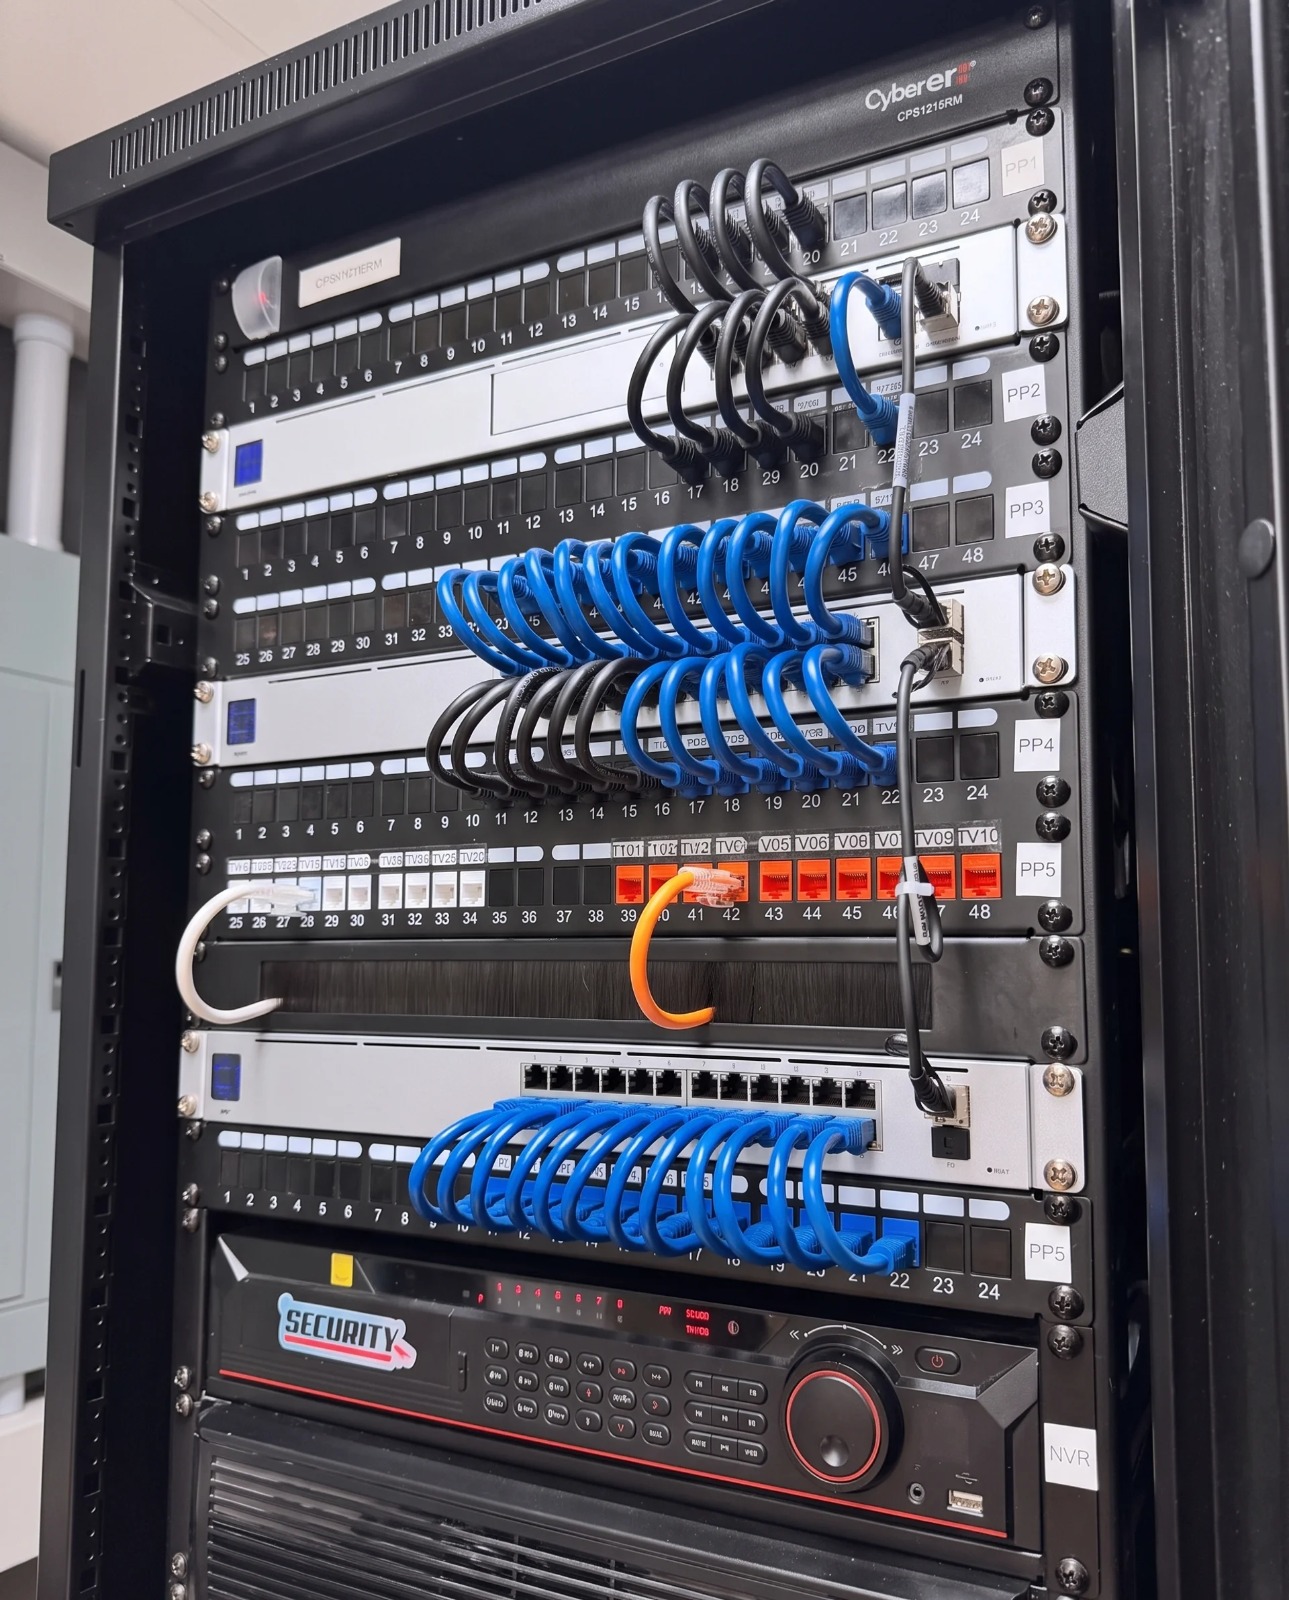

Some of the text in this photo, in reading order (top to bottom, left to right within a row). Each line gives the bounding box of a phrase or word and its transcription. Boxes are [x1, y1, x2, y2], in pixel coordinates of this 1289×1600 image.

[1005, 156, 1037, 177] PP1
[249, 403, 255, 413] 1
[271, 395, 278, 408] 2
[293, 389, 301, 402] 3
[316, 383, 324, 395] 4
[340, 376, 348, 389] 5
[364, 369, 373, 382] 6
[394, 361, 402, 374] 7
[420, 354, 428, 367] 8
[447, 347, 455, 360] 9
[471, 339, 486, 354] 10
[501, 331, 513, 345] 11
[529, 323, 543, 338] 12
[562, 314, 577, 329] 13
[592, 305, 608, 321] 14
[624, 297, 640, 313] 15
[802, 250, 821, 266] 20
[841, 240, 857, 257] 21
[879, 230, 898, 247] 22
[919, 219, 938, 236] 23
[960, 209, 980, 226] 24
[1007, 384, 1041, 403] PP2
[242, 431, 982, 580] 1 2 3 4 5 6 7 8 9 10 11 12 13 14 15 16 17 18 29 20 21 22 23 24
[1010, 500, 1044, 519] PP3
[236, 653, 250, 666] 25
[259, 650, 273, 663] 26
[282, 646, 296, 660] 27
[306, 643, 321, 656] 28
[331, 639, 345, 653] 29
[355, 636, 371, 650] 30
[385, 632, 399, 646] 31
[411, 628, 426, 642] 32
[438, 624, 453, 638] 33
[838, 567, 858, 582] 45
[919, 554, 940, 571] 47
[962, 547, 984, 564] 48
[1019, 738, 1054, 753] PP4
[235, 785, 988, 840] 1 2 3 4 5 6 7 8 9 10 11 12 13 14 15 16 17 18 19 20 21 22 23 24
[1020, 862, 1056, 878] PP5
[229, 917, 243, 929] 25
[252, 916, 267, 928] 26
[276, 916, 291, 928] 27
[300, 915, 315, 927] 28
[324, 914, 339, 927] 29
[350, 914, 365, 927] 30
[381, 913, 395, 926] 31
[408, 912, 423, 926] 32
[435, 911, 450, 925] 33
[462, 911, 478, 925] 34
[492, 910, 508, 924] 35
[521, 910, 537, 924] 36
[556, 909, 573, 923] 37
[588, 909, 604, 923] 38
[620, 908, 637, 922] 39
[687, 908, 704, 921] 41
[722, 907, 741, 921] 42
[764, 907, 783, 921] 43
[802, 906, 822, 920] 44
[842, 905, 862, 920] 45
[969, 904, 991, 919] 48
[224, 1190, 231, 1203] 1
[246, 1193, 255, 1206] 2
[269, 1196, 278, 1209] 3
[293, 1199, 301, 1212] 4
[318, 1202, 327, 1215] 5
[344, 1205, 353, 1219] 6
[374, 1208, 383, 1222] 7
[401, 1212, 409, 1225] 8
[889, 1272, 910, 1289] 22
[932, 1276, 954, 1294] 23
[978, 1282, 1000, 1300] 24
[1030, 1243, 1065, 1261] PP5
[285, 1309, 399, 1352] SECURITY
[1050, 1445, 1090, 1467] NVR
